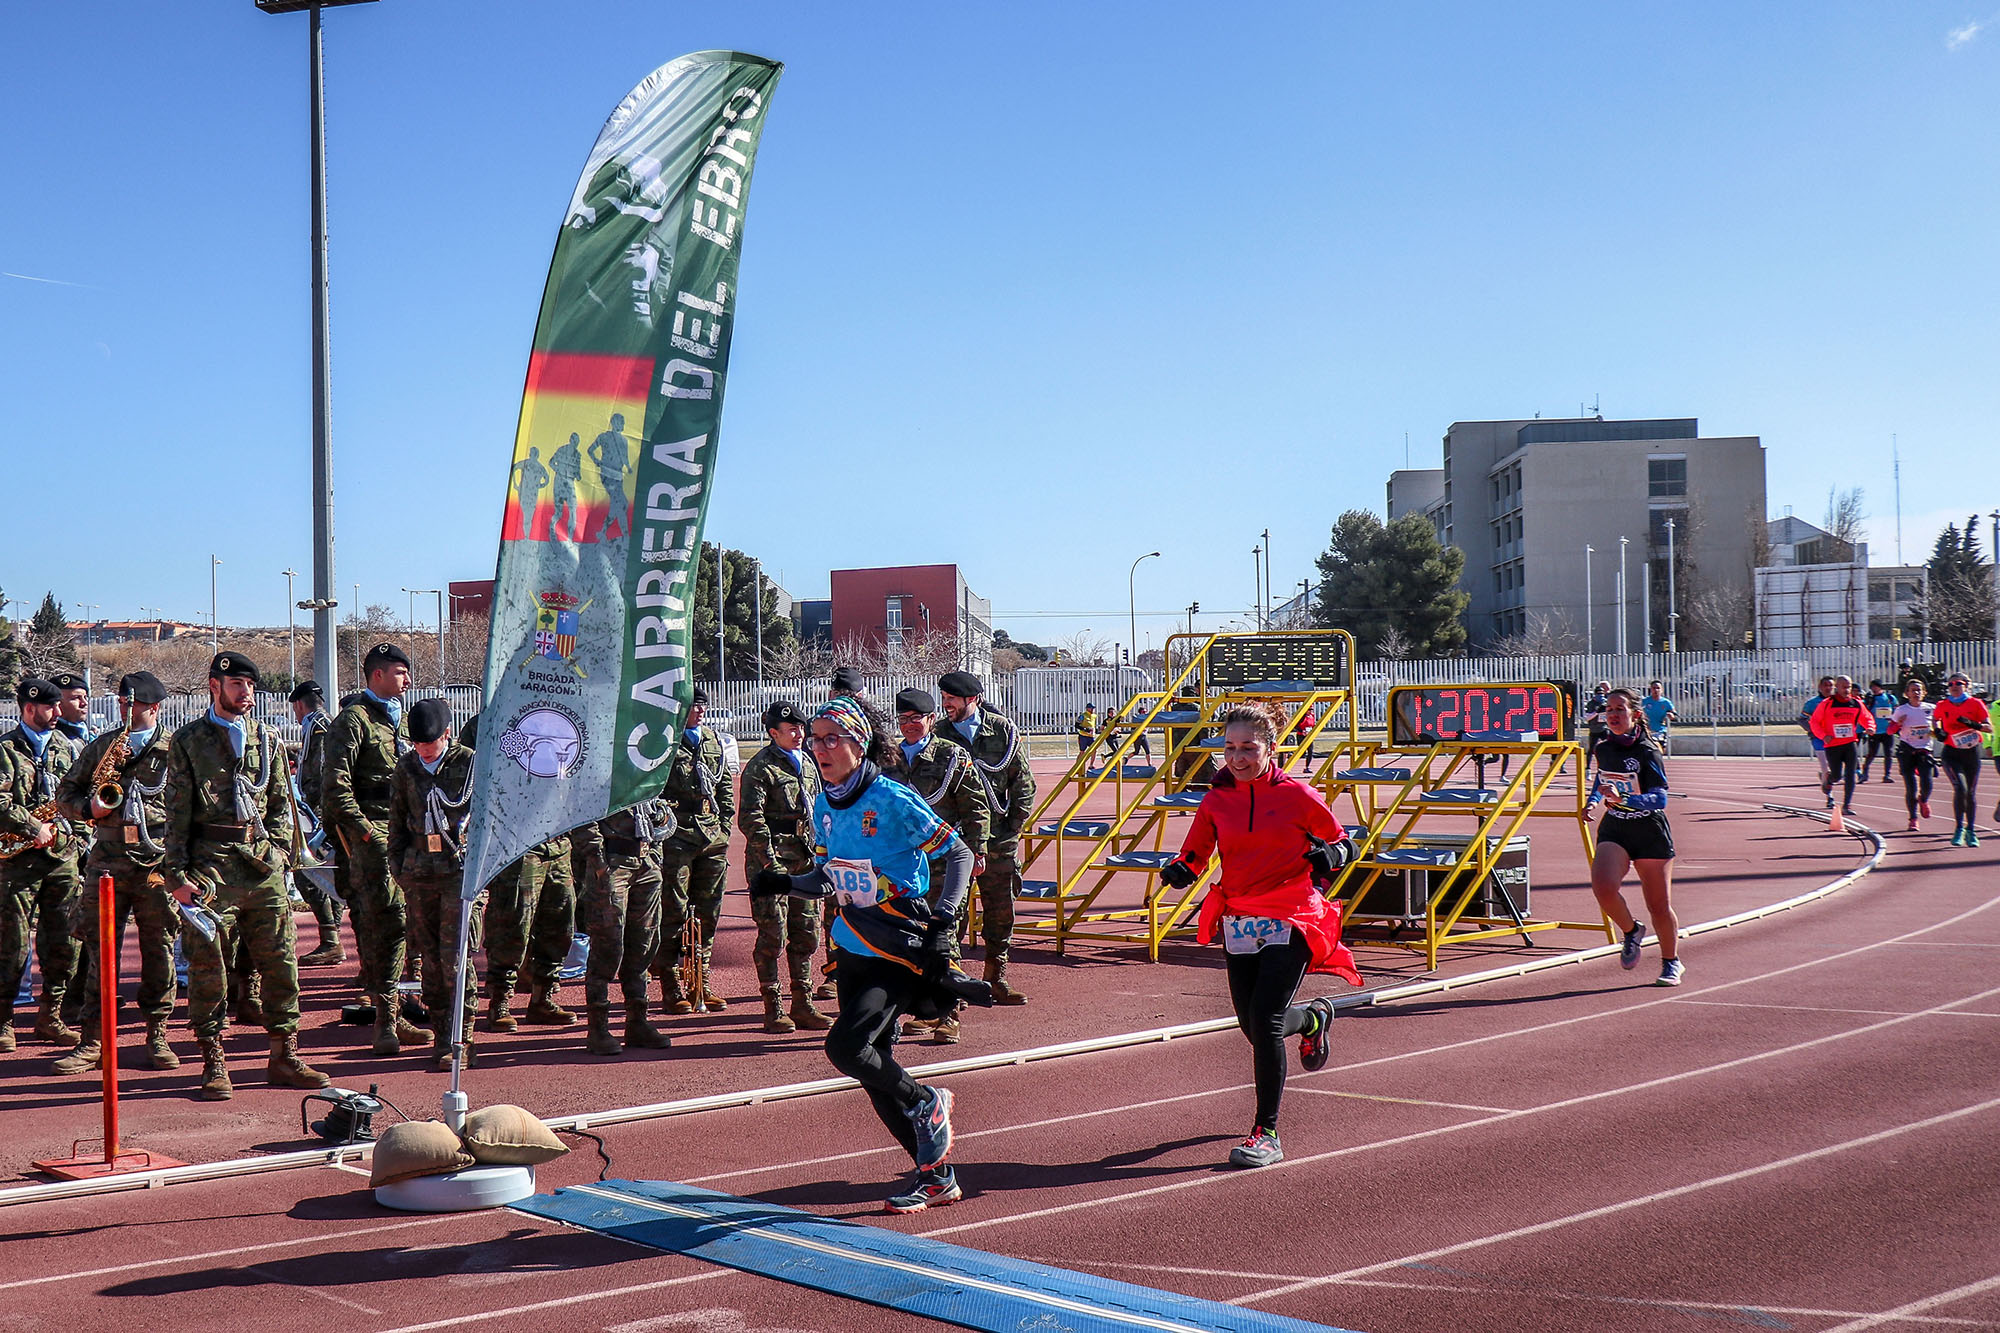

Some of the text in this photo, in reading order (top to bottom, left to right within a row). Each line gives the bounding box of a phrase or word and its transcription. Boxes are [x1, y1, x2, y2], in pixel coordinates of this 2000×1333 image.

[627, 86, 762, 772] CARRERA DEL EBRO
[528, 671, 576, 685] BRIGADA
[518, 699, 551, 716] ARAGÓN
[551, 701, 583, 723] DEPORTE
[1415, 687, 1558, 738] 1:20:26
[577, 721, 590, 740] PARA
[582, 740, 590, 751] LA
[566, 752, 588, 778] UNESCO
[1626, 809, 1651, 820] PRO
[1231, 918, 1284, 938] 1421
